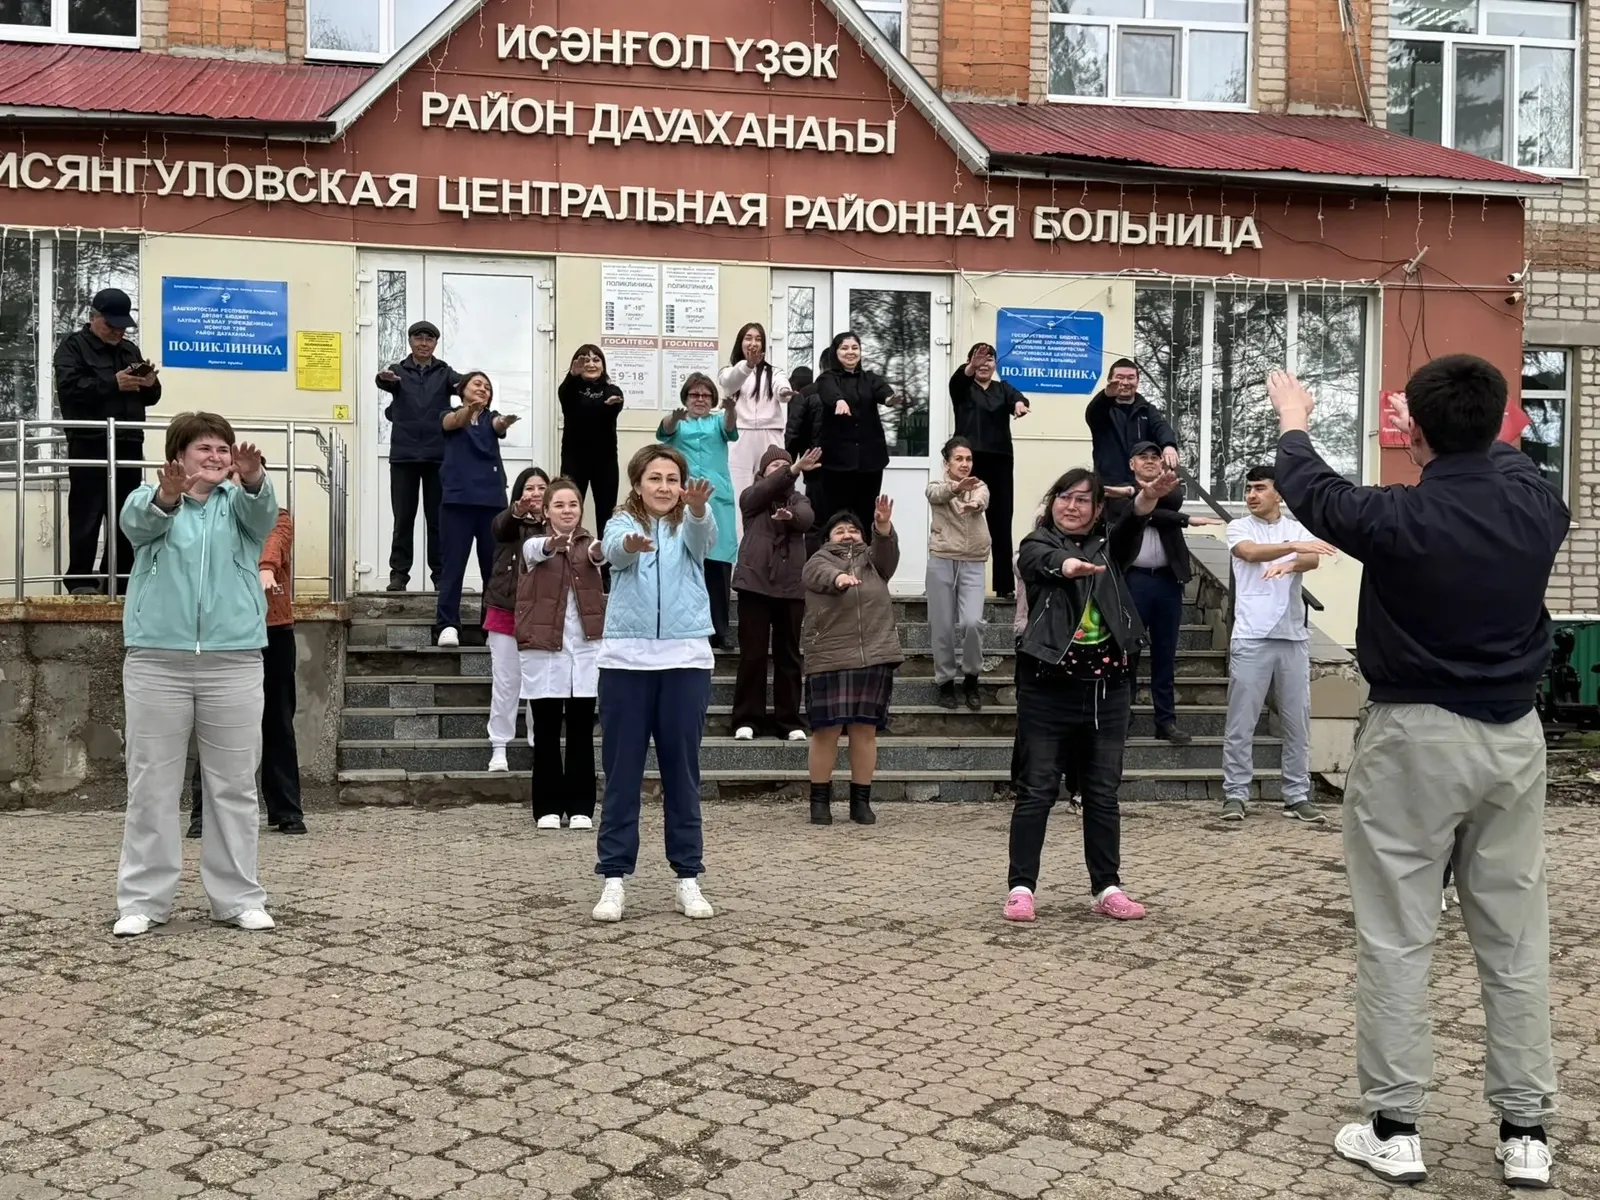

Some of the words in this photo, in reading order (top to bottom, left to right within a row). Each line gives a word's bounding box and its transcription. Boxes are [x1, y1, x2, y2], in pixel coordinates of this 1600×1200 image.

[498, 23, 710, 71] ИҪӘНҒОЛ
[725, 37, 838, 83] ҮҘӘК
[421, 91, 574, 136] РАЙОН
[588, 103, 896, 154] ДАУАХАНАҺЫ
[0, 152, 418, 209] ИСЯНГУЛОВСКАЯ
[438, 175, 768, 227] ЦЕНТРАЛЬНАЯ
[785, 193, 1015, 238] РАЙОННАЯ
[1033, 206, 1263, 255] БОЛЬНИЦА
[606, 280, 653, 288] ПОЛИКЛИНИКА
[667, 282, 714, 290] ПОЛИКЛИНИКА
[168, 340, 283, 356] ПОЛИКЛИНИКА
[604, 338, 655, 346] ГОСАПТЕКА
[665, 340, 715, 348] ГОСАПТЕКА
[1001, 366, 1098, 380] ПОЛИКЛИНИКА
